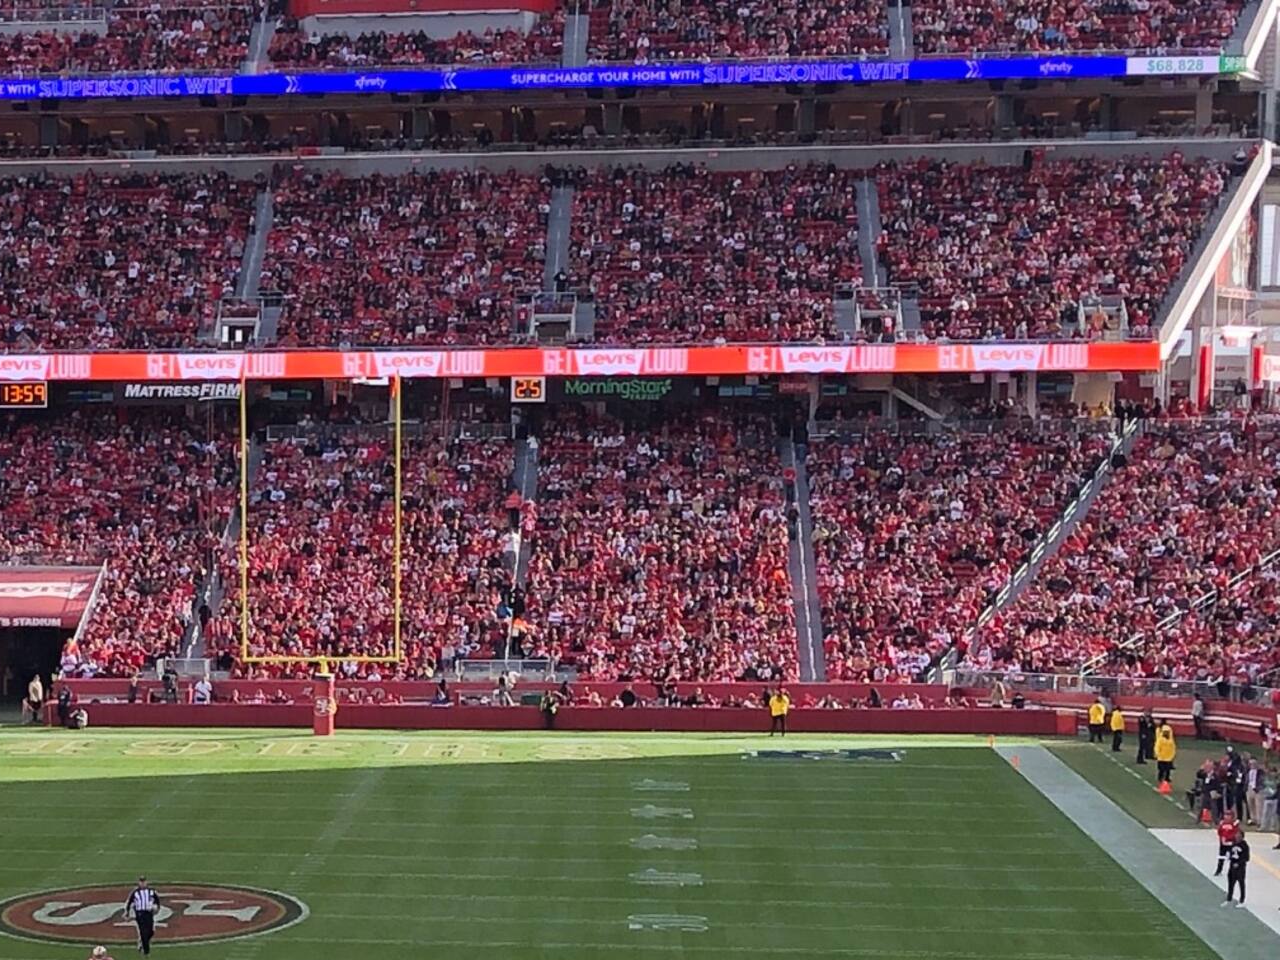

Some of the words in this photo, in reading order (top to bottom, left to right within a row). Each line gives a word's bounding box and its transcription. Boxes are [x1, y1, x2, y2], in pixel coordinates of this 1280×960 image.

[511, 73, 594, 84] SUPERCHARGE
[597, 72, 629, 83] YOUR
[631, 71, 667, 82] HOME
[669, 70, 700, 81] WITH
[703, 63, 854, 84] SUPERSONIC
[1039, 62, 1074, 75] xfinity
[1147, 59, 1204, 74] $68,828
[8, 84, 36, 94] WITH
[39, 78, 180, 97] SUPERSONIC
[354, 76, 387, 90] xfinity
[147, 353, 175, 378] GET
[342, 353, 374, 377] GET
[544, 351, 573, 374] GET
[747, 348, 778, 372] GET
[938, 346, 970, 370] GET
[3, 385, 45, 402] 13:59
[514, 380, 541, 399] 25
[12, 617, 62, 628] STADIUM
